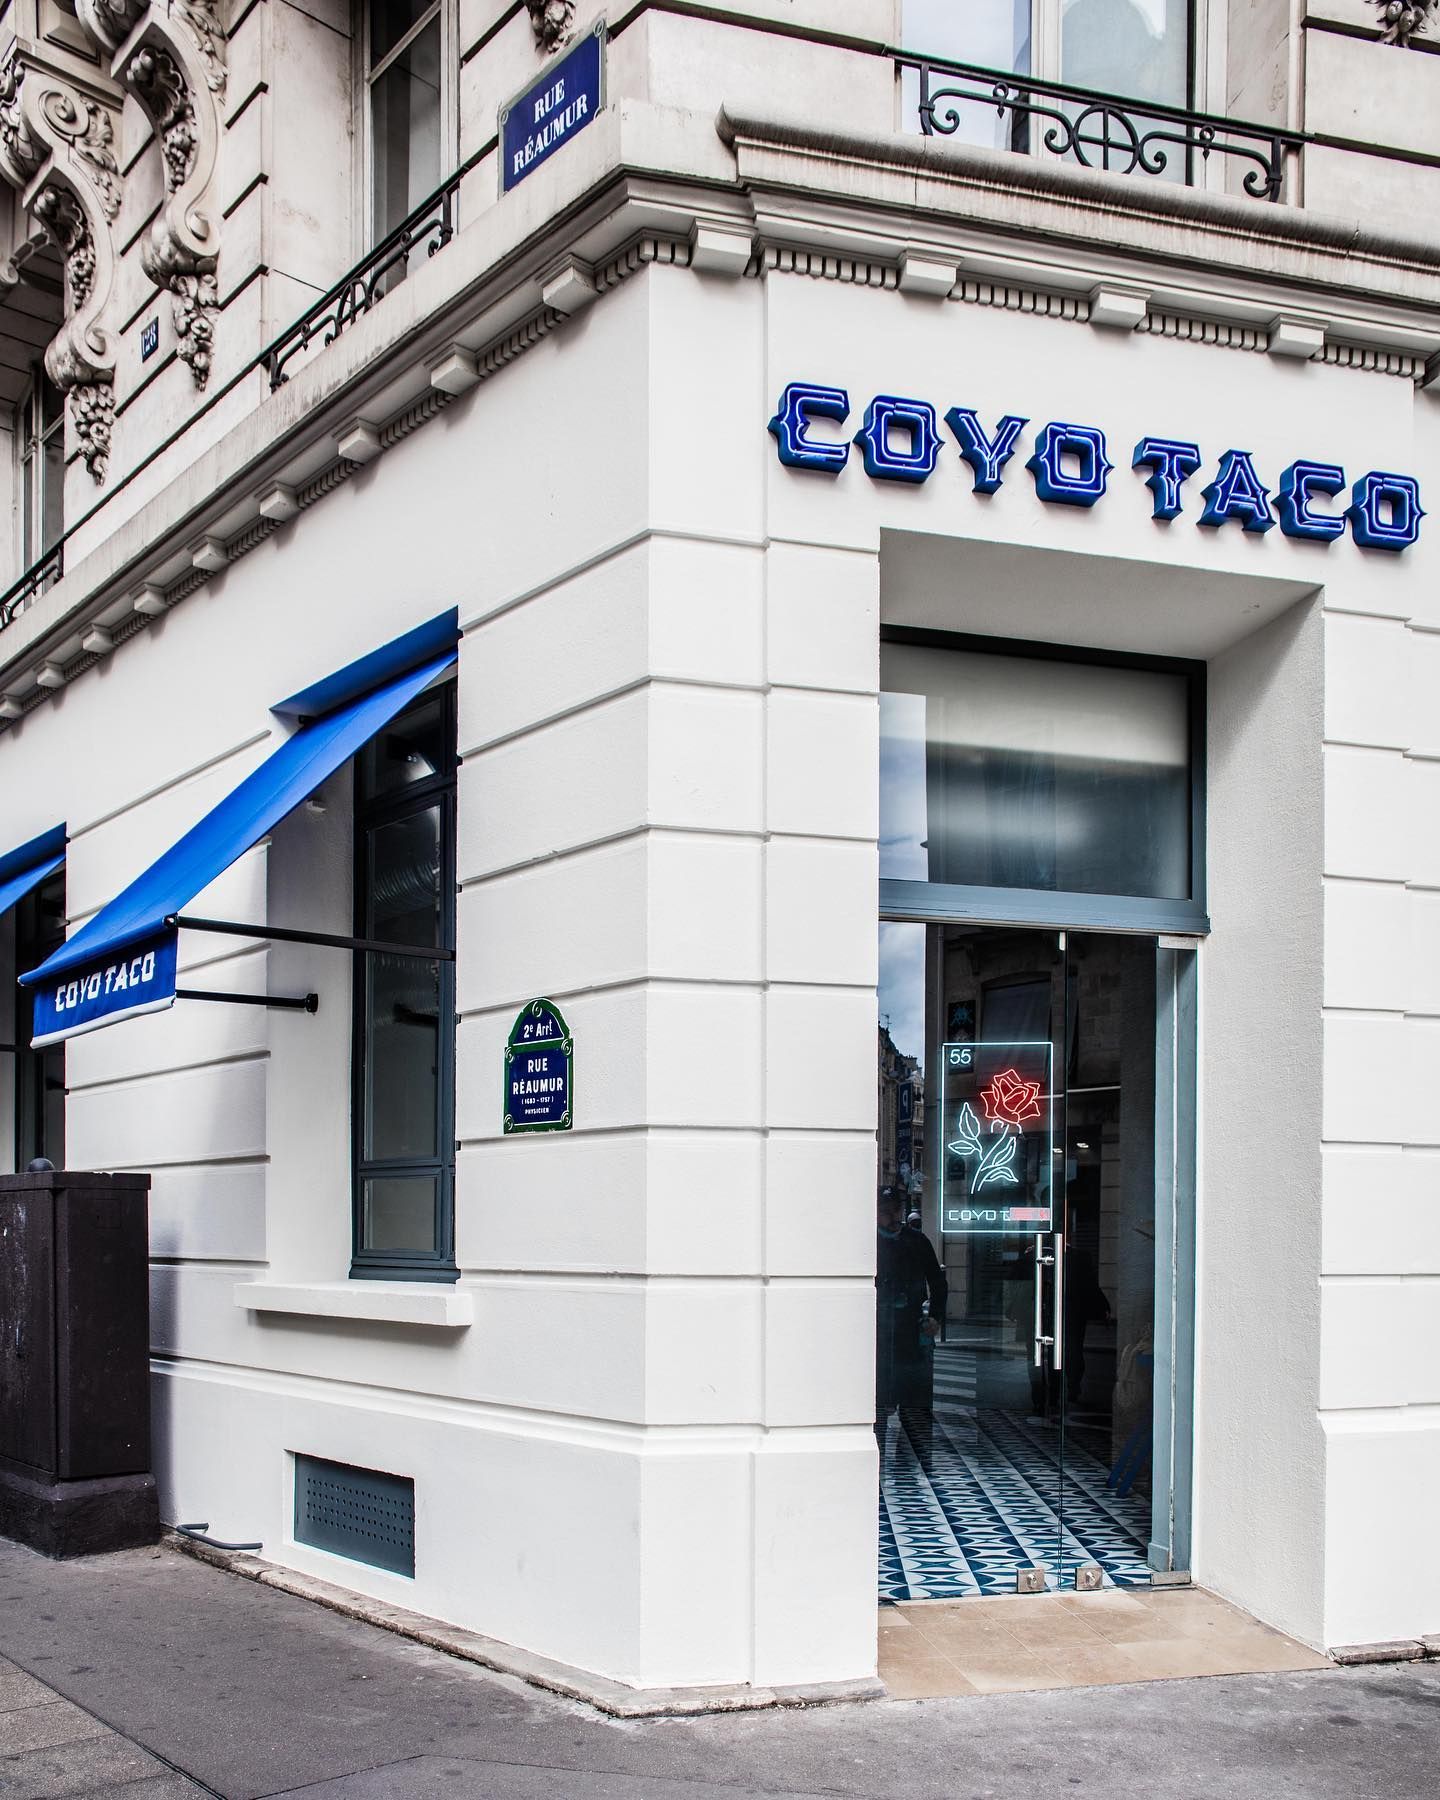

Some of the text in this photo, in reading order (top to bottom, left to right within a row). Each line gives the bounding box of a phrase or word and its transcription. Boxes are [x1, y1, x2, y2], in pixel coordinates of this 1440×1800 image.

[534, 78, 565, 124] RUE
[513, 93, 588, 176] RÉAUMUR
[768, 382, 1427, 552] COYO TACO
[55, 951, 156, 1013] COYO TACO
[527, 1058, 548, 1073] RUE
[949, 1049, 972, 1065] 55
[512, 1077, 564, 1095] RÉAUMUR
[948, 1209, 997, 1221] COYO
